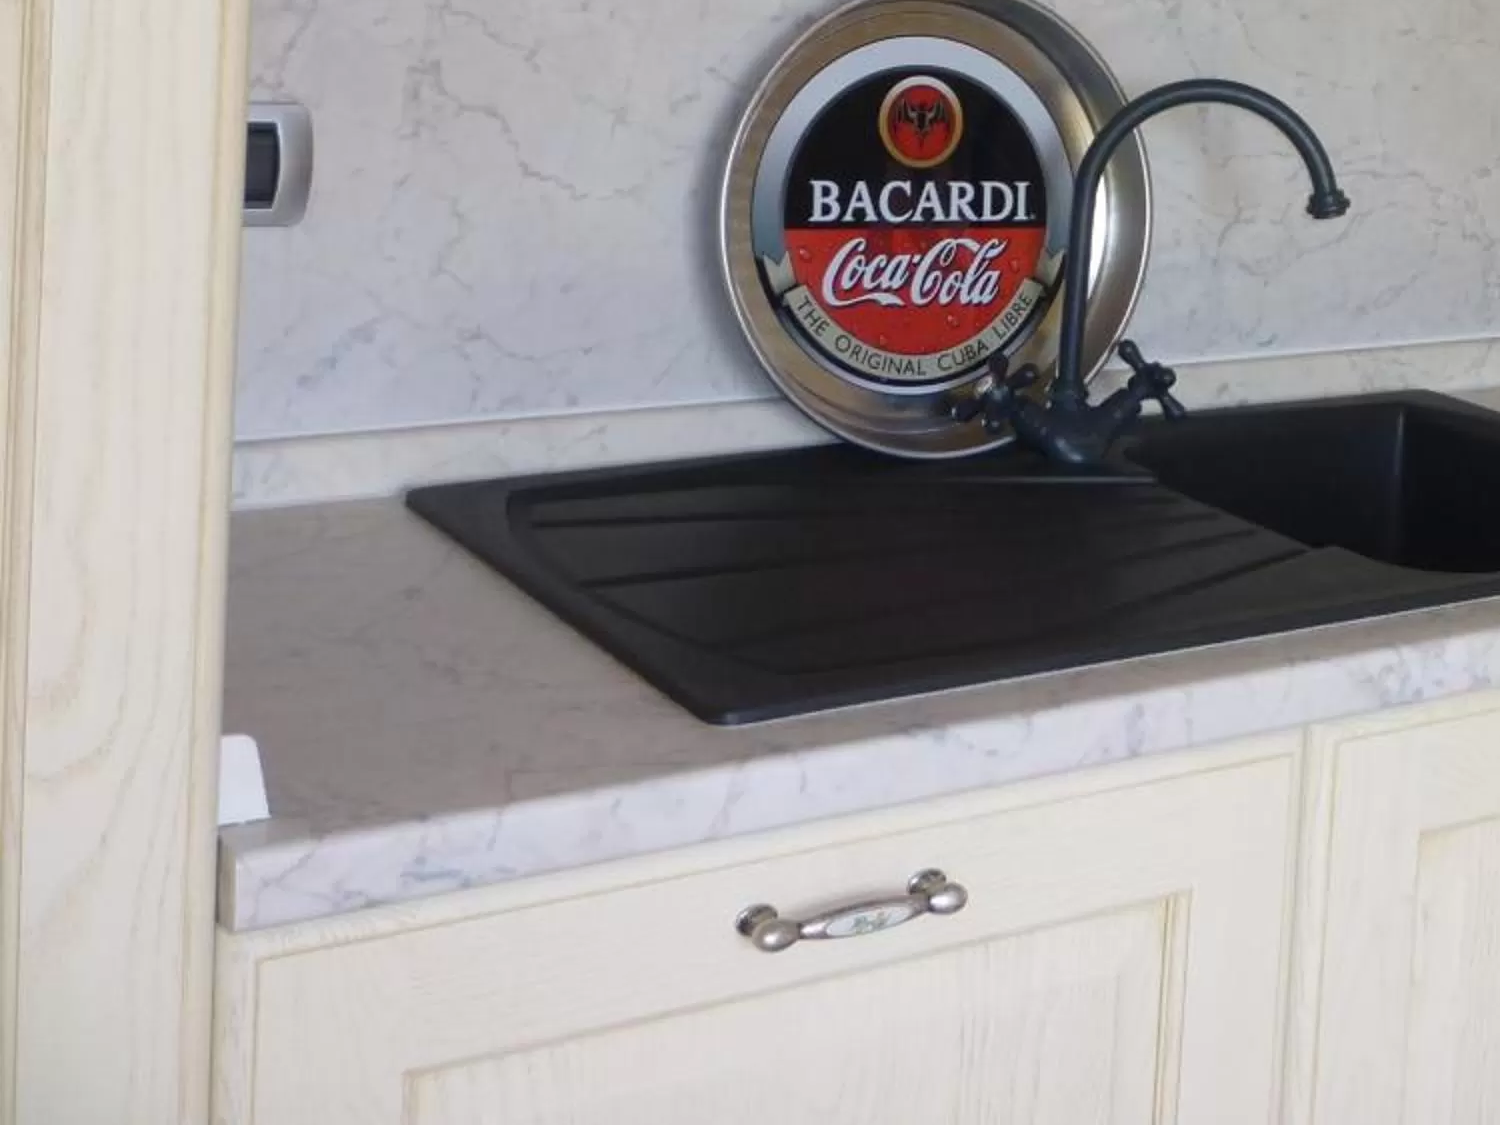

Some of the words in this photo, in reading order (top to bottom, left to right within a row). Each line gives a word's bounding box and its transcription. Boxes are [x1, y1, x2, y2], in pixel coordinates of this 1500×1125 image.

[809, 180, 1031, 223] BACARDI
[796, 295, 828, 336] THE
[835, 334, 926, 376] ORIGINAL
[937, 341, 989, 371] CUBA
[995, 294, 1034, 342] LIBRE
